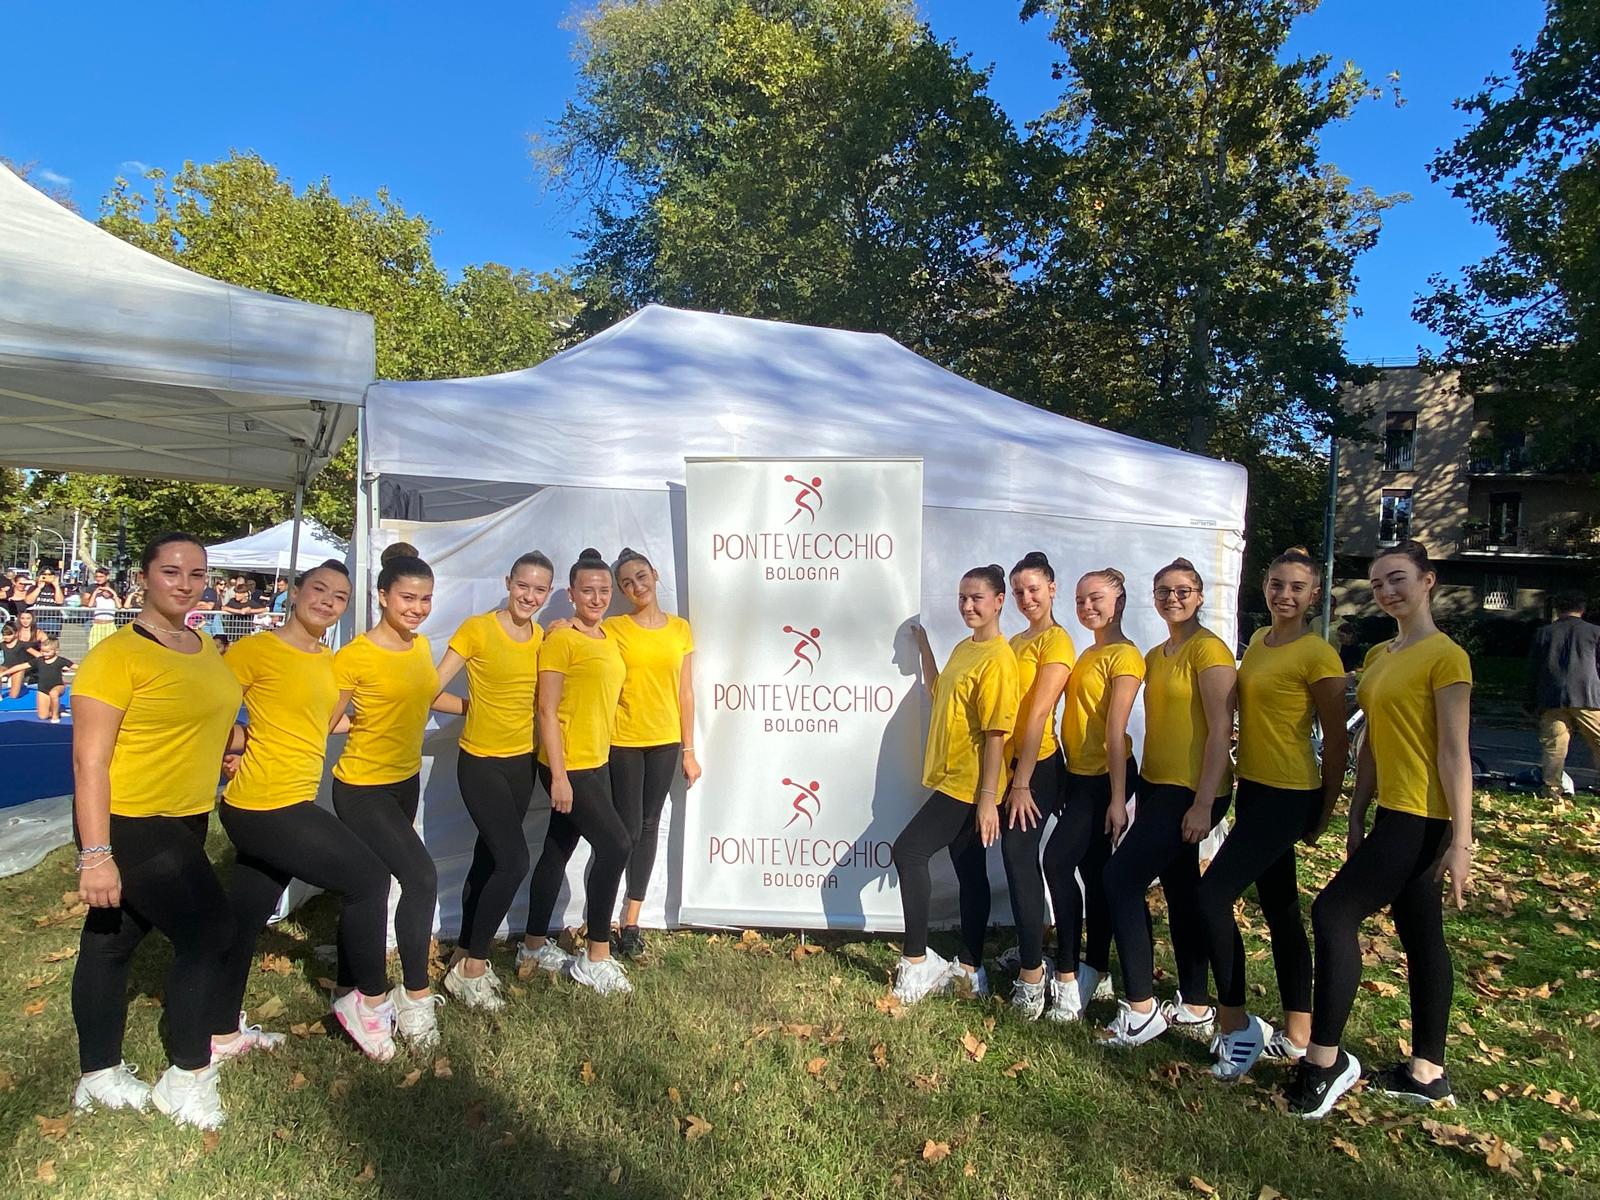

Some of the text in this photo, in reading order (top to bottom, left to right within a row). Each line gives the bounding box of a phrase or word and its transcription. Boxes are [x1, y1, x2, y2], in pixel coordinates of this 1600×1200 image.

[712, 532, 893, 560] PONTEVECCHIO
[765, 566, 839, 581] BOLOGNA
[713, 683, 894, 712] PONTEVECCHIO
[764, 718, 838, 733] BOLOGNA
[709, 836, 894, 868] PONTEVECCHIO
[763, 872, 838, 889] BOLOGNA
